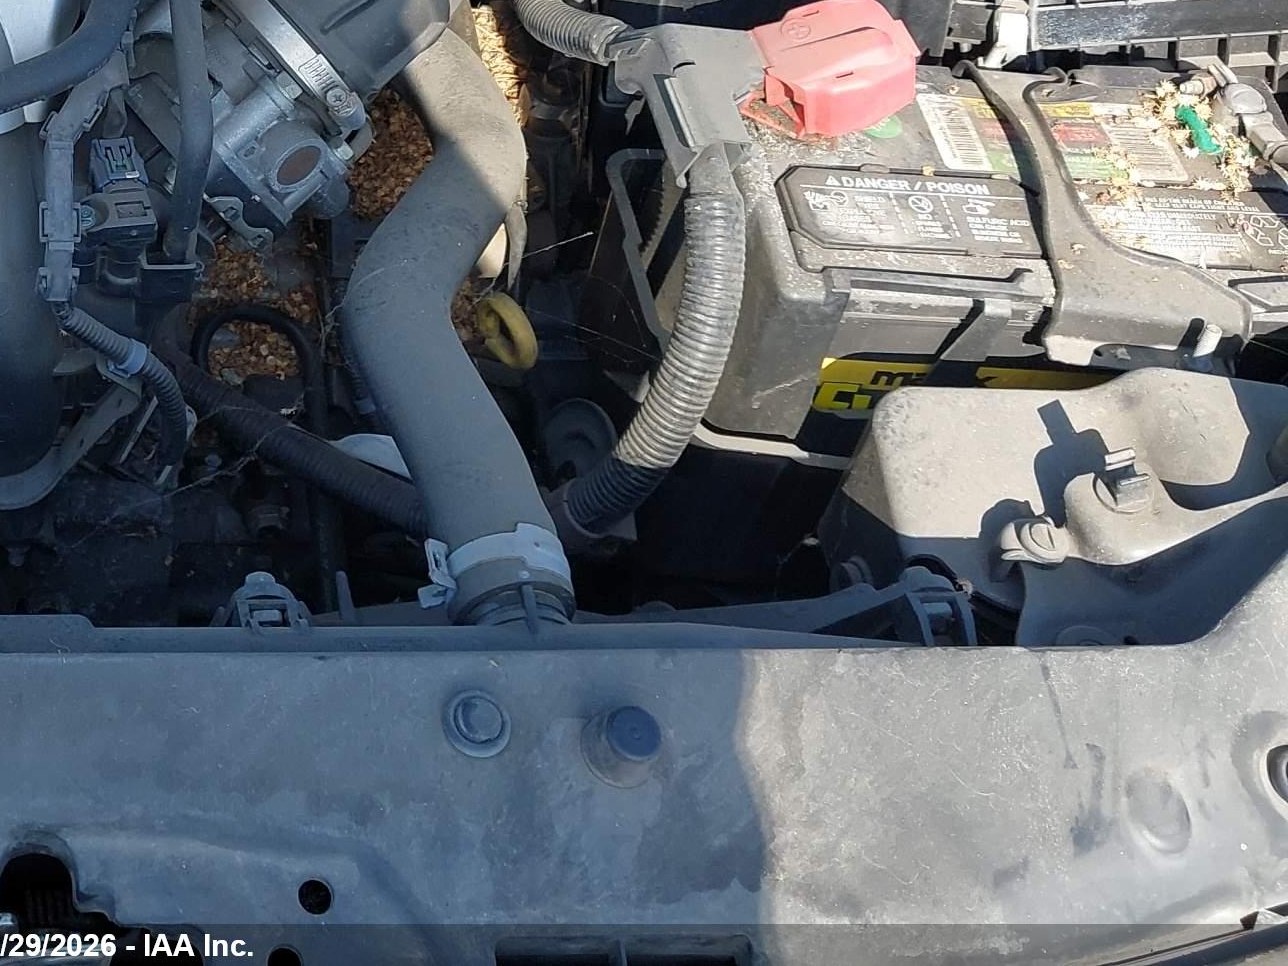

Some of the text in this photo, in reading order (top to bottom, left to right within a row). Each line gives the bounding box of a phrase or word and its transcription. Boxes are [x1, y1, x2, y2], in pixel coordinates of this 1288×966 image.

[840, 176, 990, 195] DANGER / POISON
